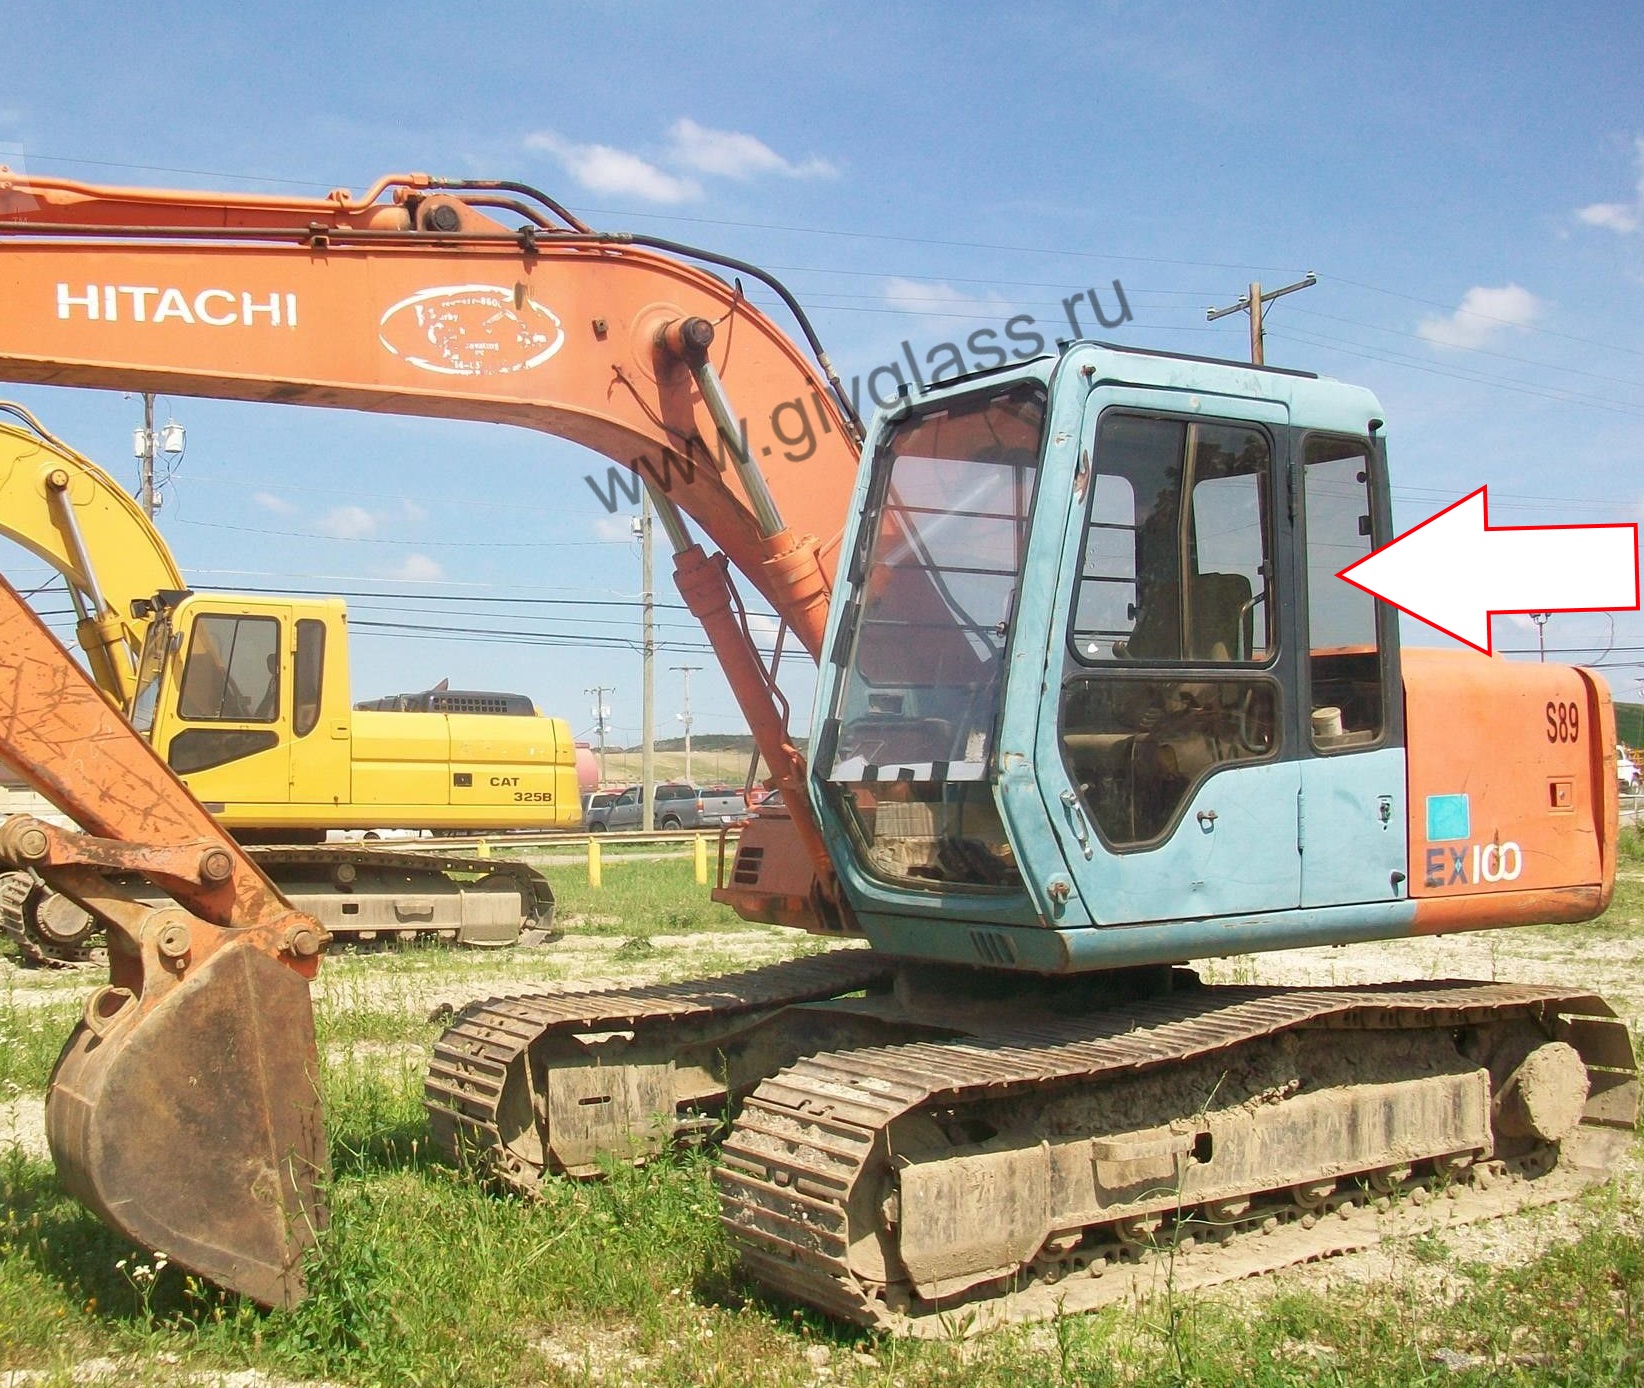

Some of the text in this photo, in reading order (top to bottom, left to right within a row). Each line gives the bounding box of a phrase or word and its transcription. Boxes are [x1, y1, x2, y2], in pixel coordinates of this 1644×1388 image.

[56, 283, 298, 327] HITACHI
[1546, 701, 1579, 744] S89
[489, 777, 520, 787] CAT
[513, 792, 552, 802] 325B
[1425, 841, 1522, 888] EX100
